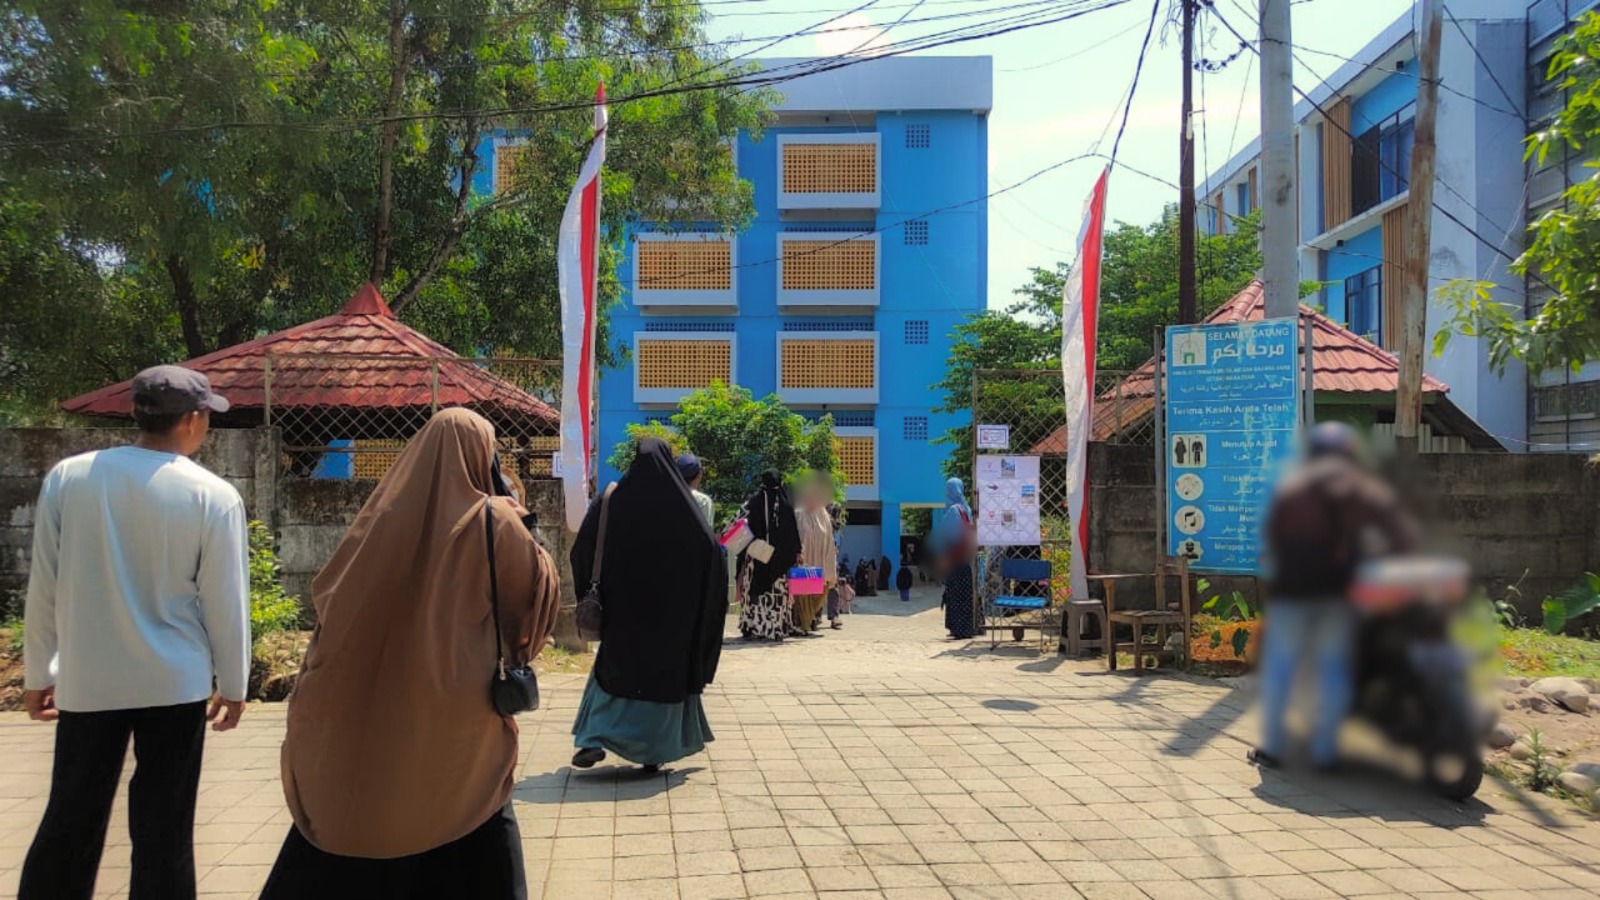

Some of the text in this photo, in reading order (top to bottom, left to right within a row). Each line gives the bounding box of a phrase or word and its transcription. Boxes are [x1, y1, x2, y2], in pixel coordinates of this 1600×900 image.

[1208, 327, 1289, 341] SELAMAT DATANG
[1173, 403, 1289, 416] Terima Kasih Anda Telah
[1221, 440, 1255, 449] Menutup
